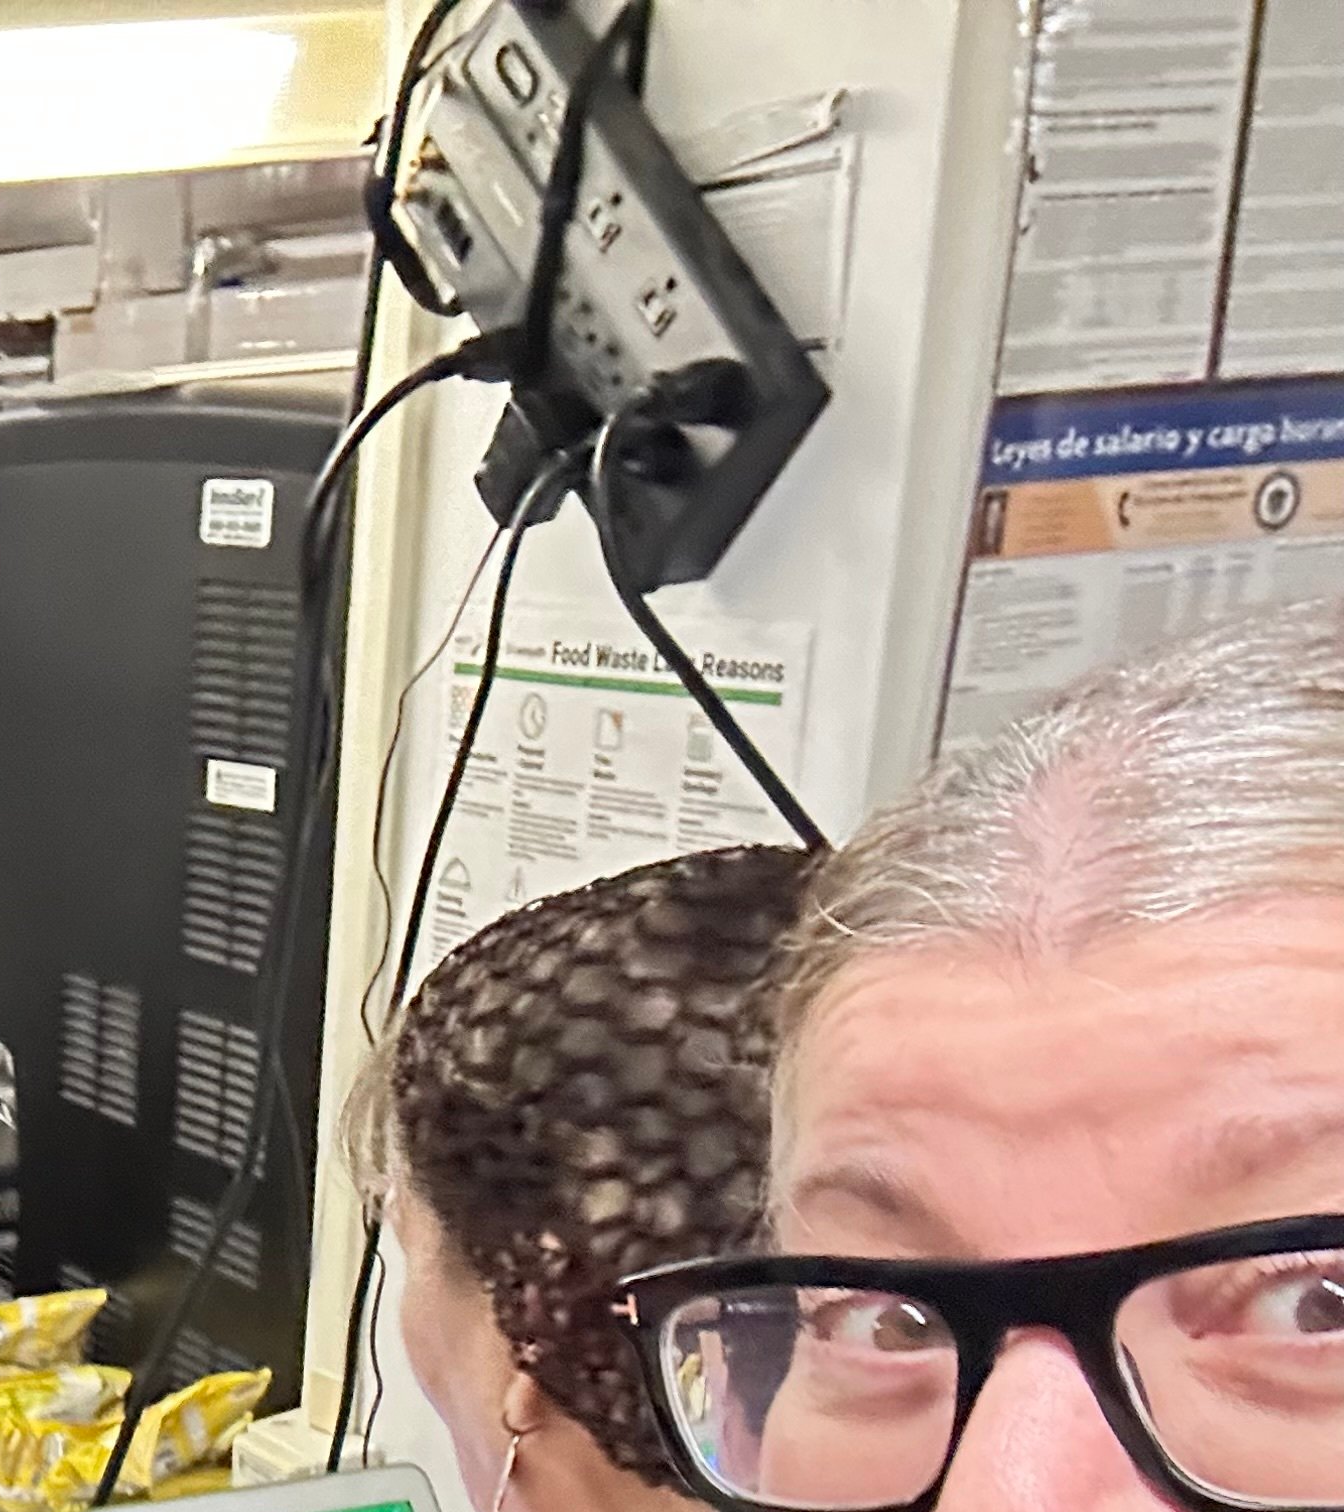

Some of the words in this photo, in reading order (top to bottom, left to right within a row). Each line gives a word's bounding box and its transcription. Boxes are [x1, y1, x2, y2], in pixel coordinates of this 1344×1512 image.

[1057, 426, 1089, 459] de
[1093, 424, 1181, 456] salario
[1185, 428, 1203, 459] y
[551, 640, 591, 668] Food
[596, 645, 648, 672] Waste
[701, 652, 786, 683] Reasons
